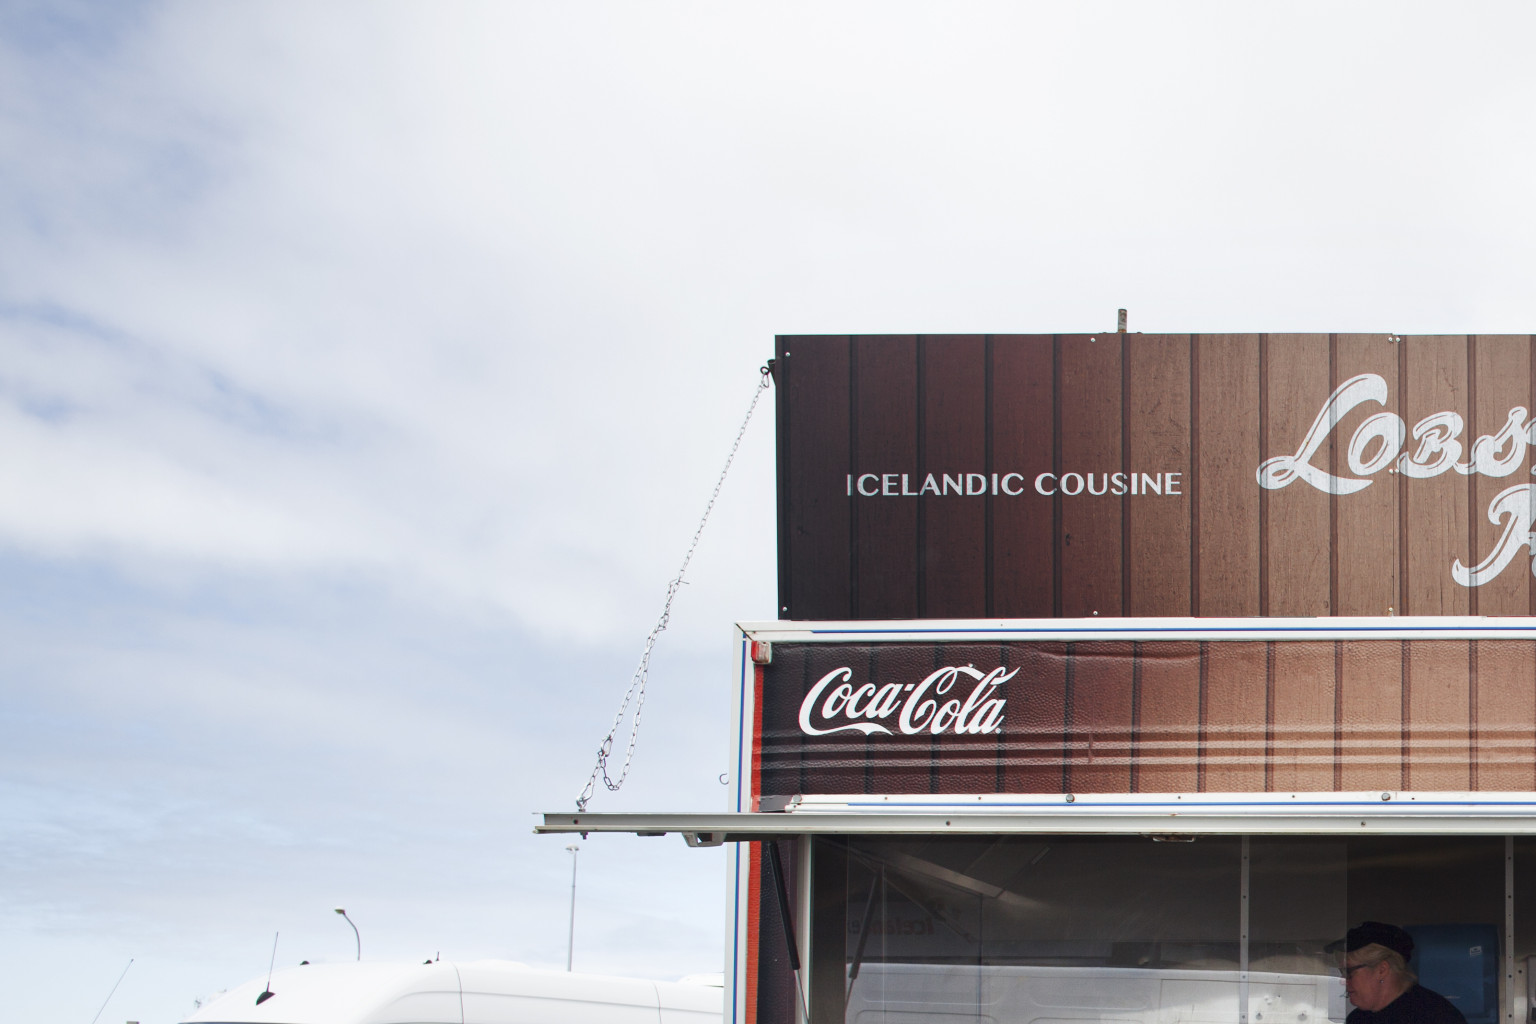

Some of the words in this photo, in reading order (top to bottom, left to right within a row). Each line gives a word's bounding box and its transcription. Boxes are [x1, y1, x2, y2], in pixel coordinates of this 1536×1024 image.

[846, 472, 1025, 498] ICELANDIC
[1034, 471, 1183, 497] COUSINE
[798, 664, 1022, 736] Coca-Cola
